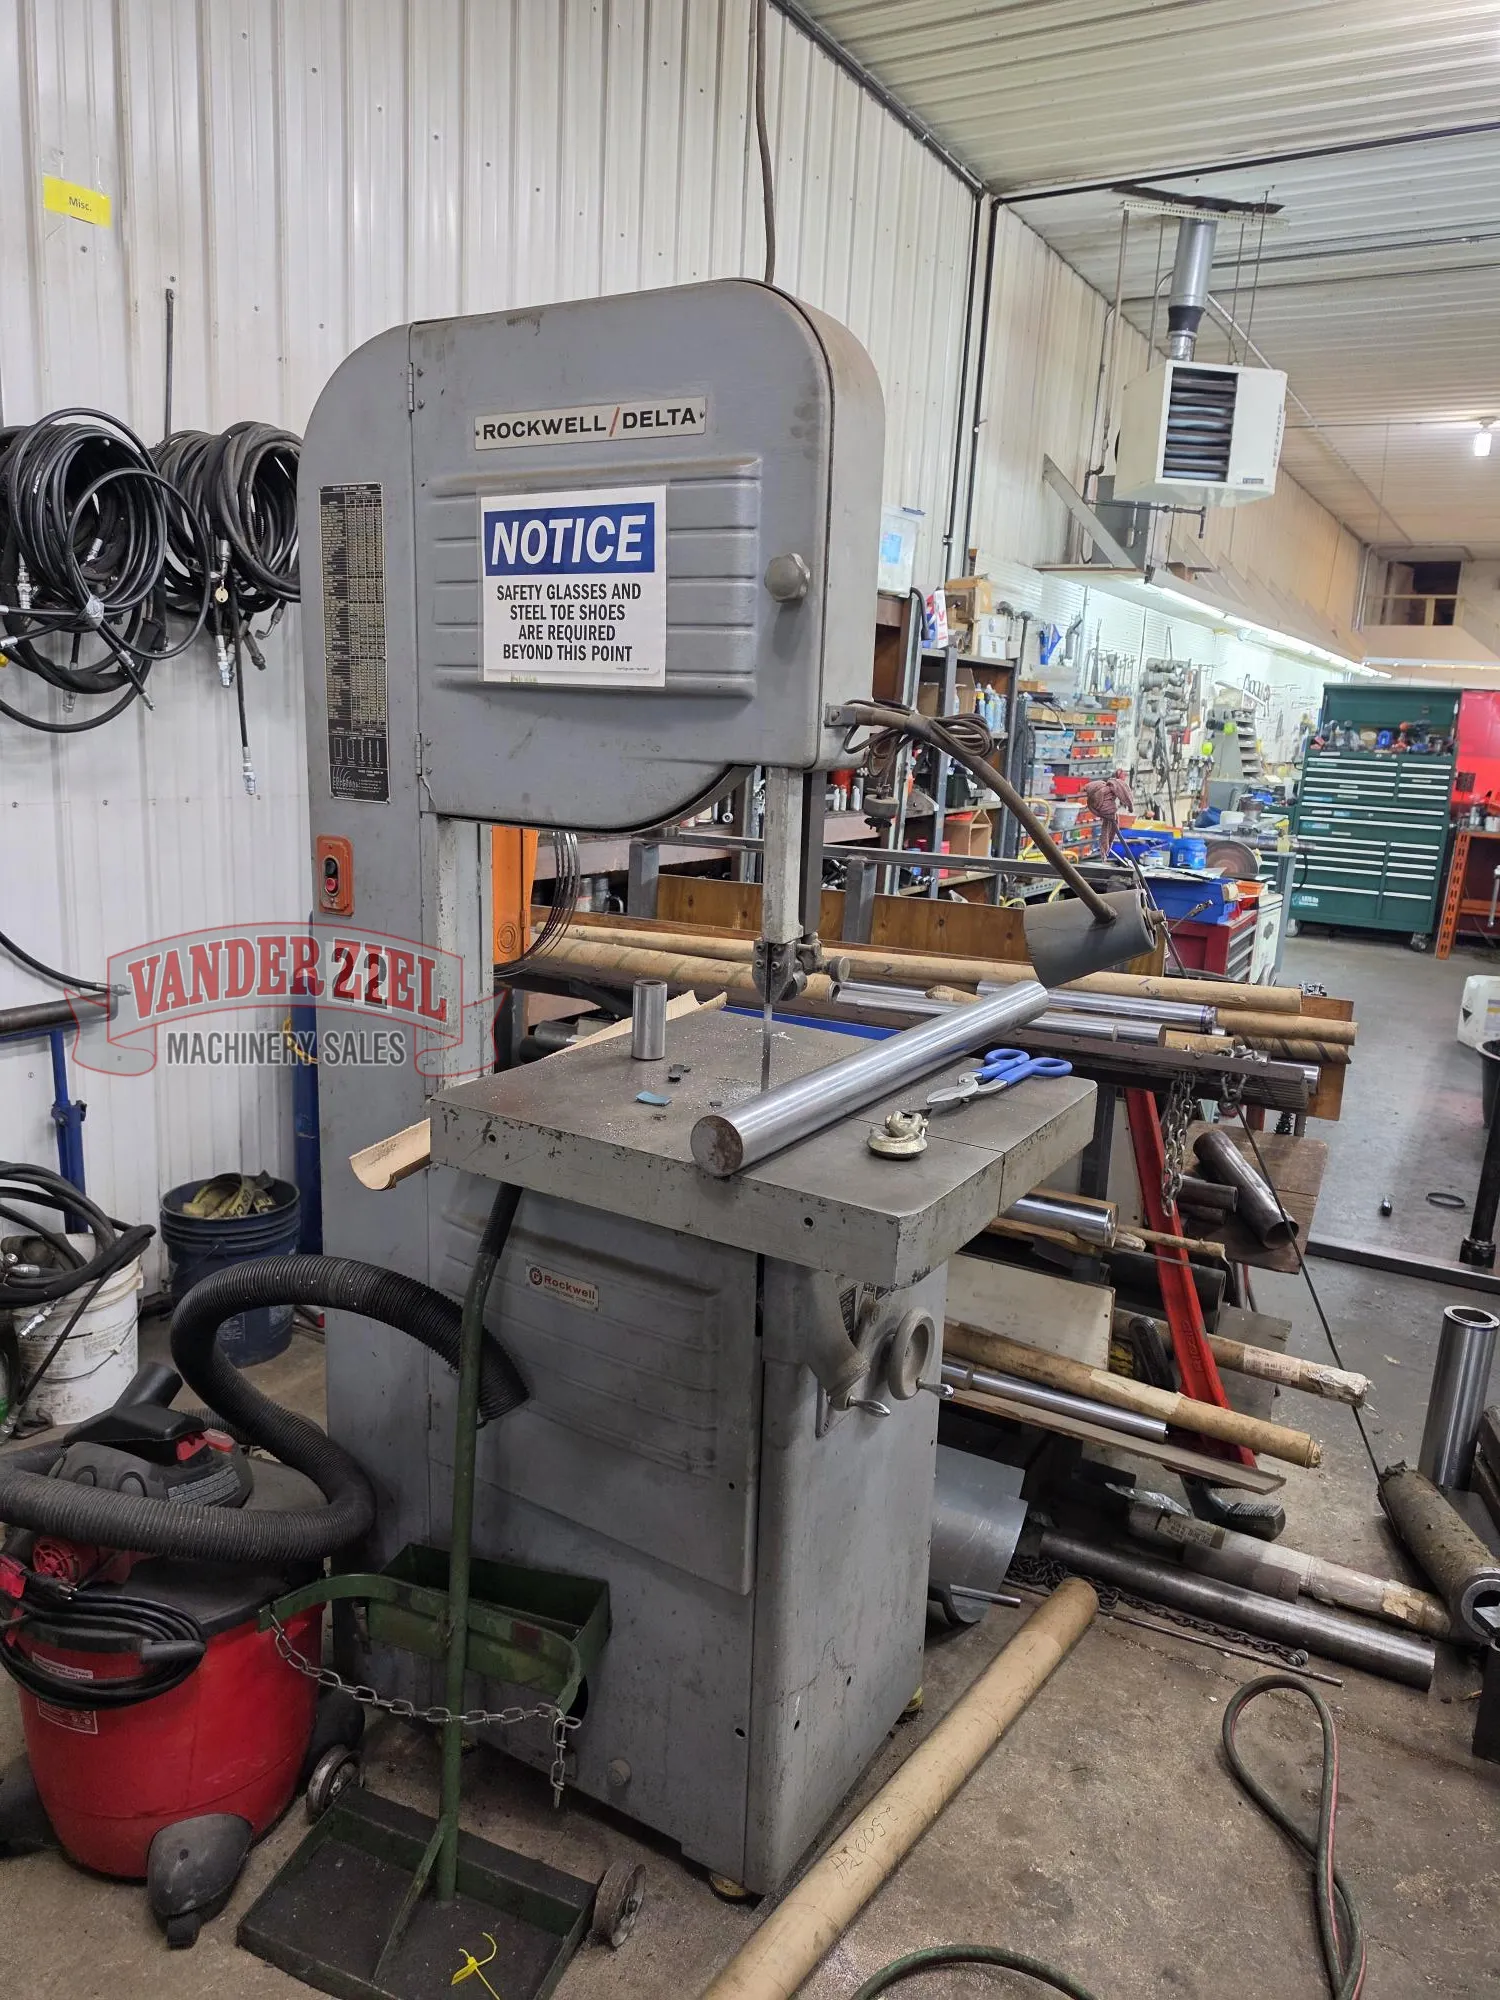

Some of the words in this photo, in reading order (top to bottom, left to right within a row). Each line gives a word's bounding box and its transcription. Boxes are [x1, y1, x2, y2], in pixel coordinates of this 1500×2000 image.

[68, 196, 92, 212] Misc.
[491, 514, 647, 565] NOTICE
[496, 584, 543, 600] SAFETY
[546, 583, 607, 600] GLASSES
[611, 583, 642, 600] AND
[510, 604, 547, 620] STEEL
[550, 604, 575, 620] TOE
[579, 604, 626, 621] SHOES
[518, 625, 544, 640] ARE
[547, 624, 616, 643] REQUIRED
[503, 644, 553, 660] BEYOND
[557, 645, 587, 661] THIS
[591, 645, 633, 662] POINT
[331, 947, 388, 1010] 22
[543, 1274, 595, 1300] Rockwell
